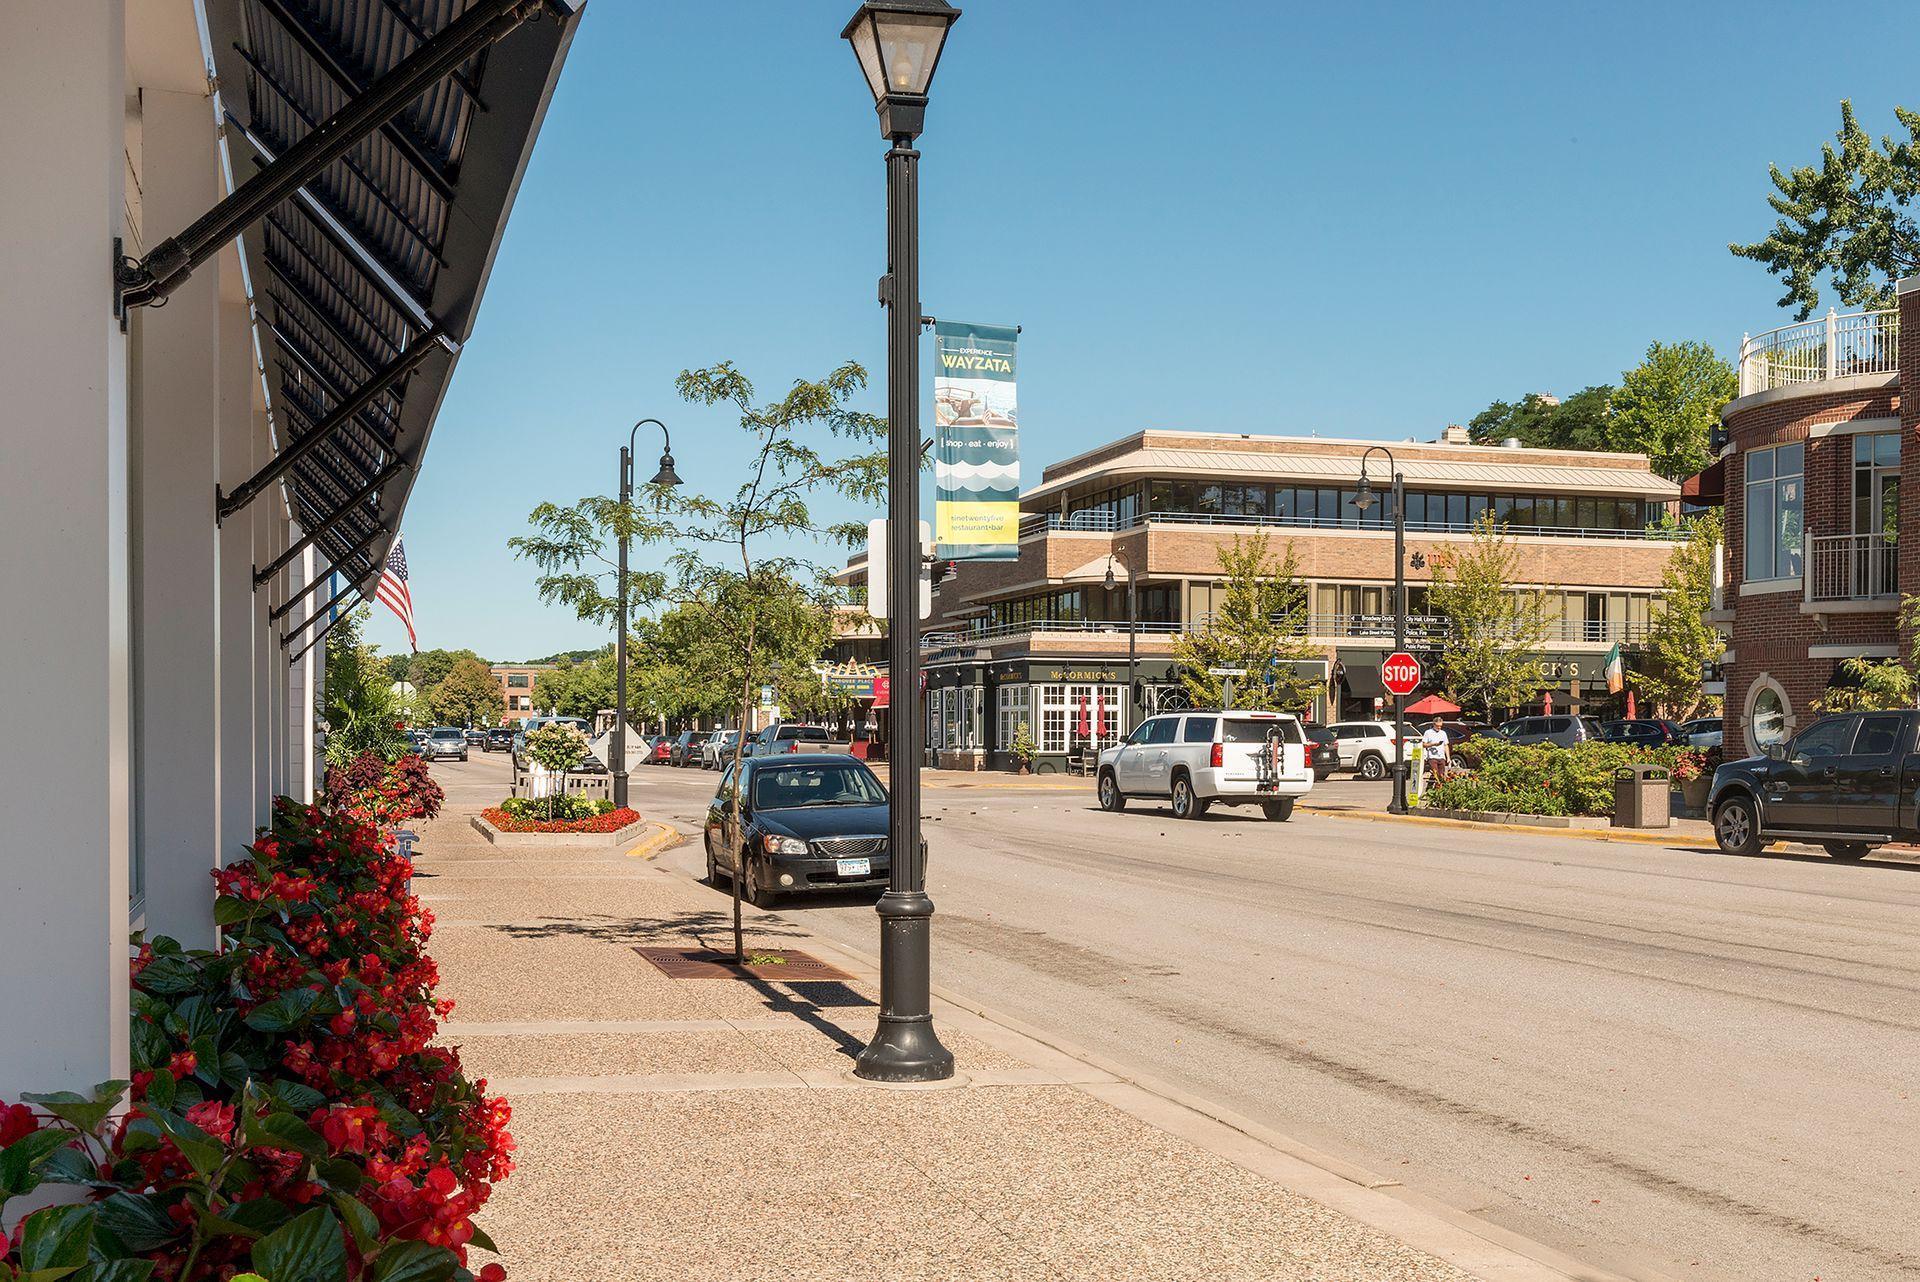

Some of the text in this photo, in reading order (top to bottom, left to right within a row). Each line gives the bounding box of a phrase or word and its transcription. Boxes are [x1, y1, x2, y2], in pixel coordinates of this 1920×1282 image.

[960, 348, 993, 356] EXPERIENCE
[941, 354, 1011, 373] WAYZATA
[968, 440, 982, 448] eat
[987, 440, 1009, 449] enjoy
[1384, 665, 1418, 682] STOP
